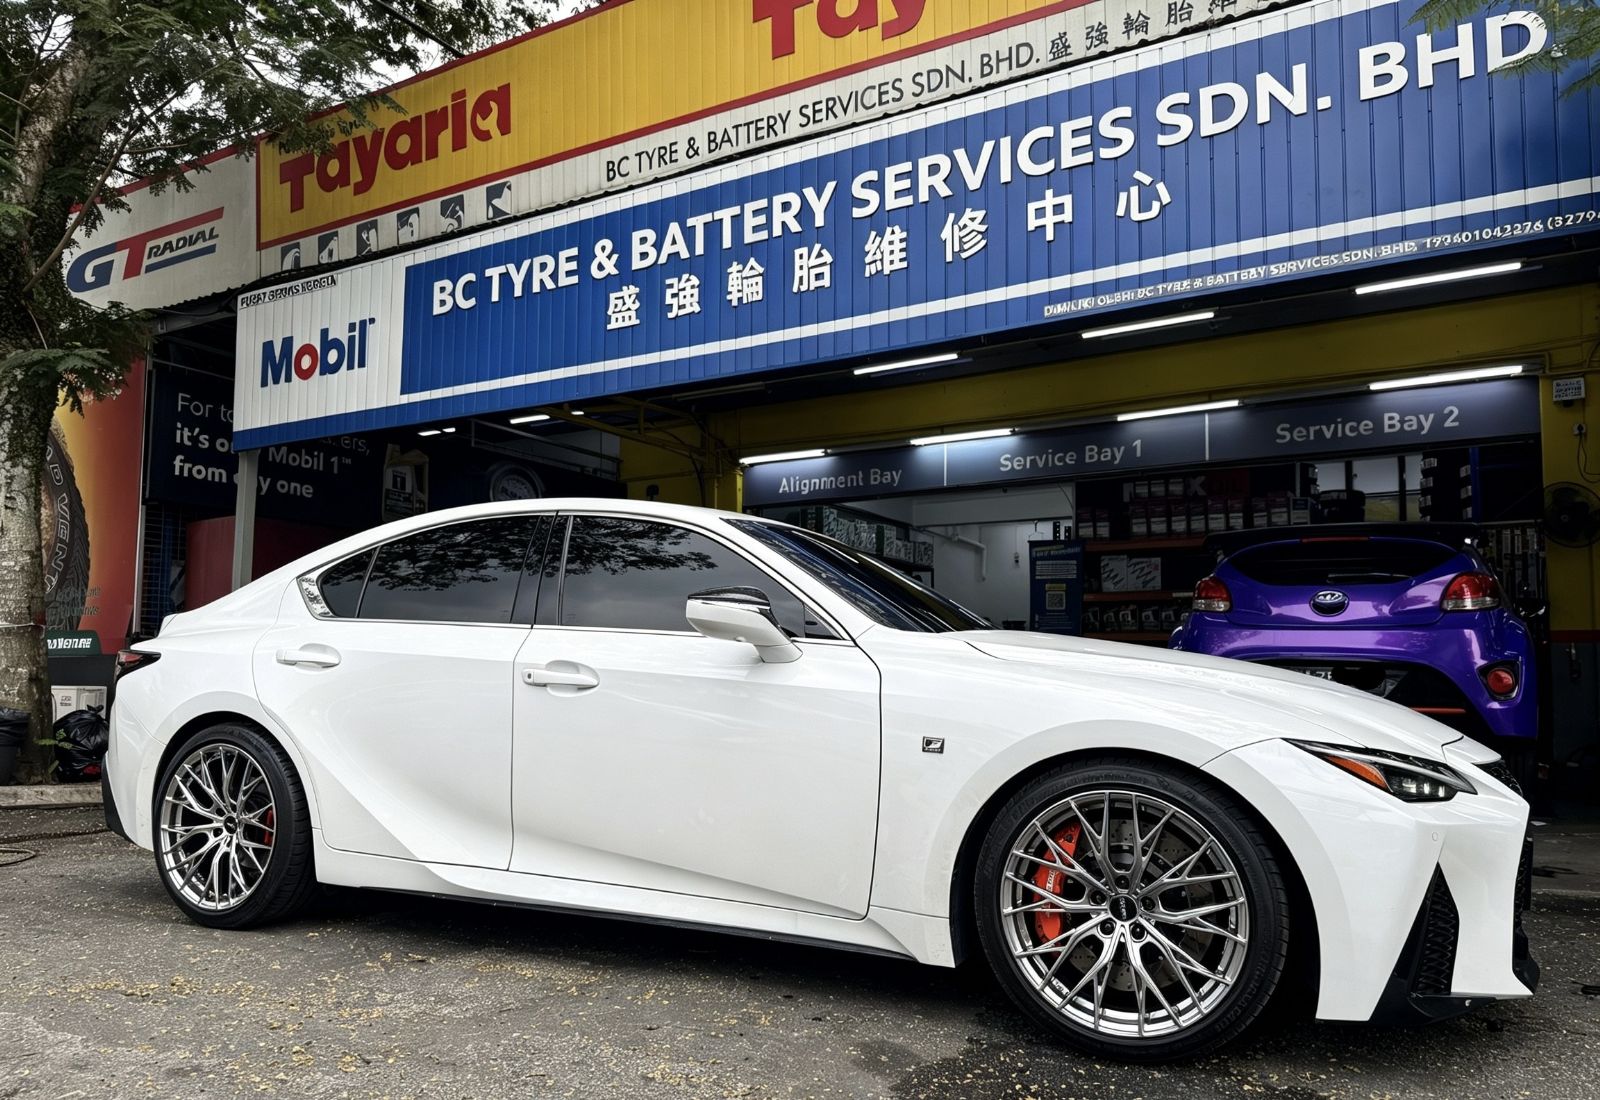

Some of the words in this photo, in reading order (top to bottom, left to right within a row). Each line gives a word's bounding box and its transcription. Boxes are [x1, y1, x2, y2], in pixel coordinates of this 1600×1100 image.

[606, 156, 630, 182] BC
[635, 141, 679, 173] TYRE
[685, 136, 700, 160] &
[707, 113, 788, 154] BATTERY
[798, 77, 904, 128] SERVICES
[911, 59, 973, 98] SDN.
[979, 41, 1041, 79] BHD.
[279, 82, 511, 214] Tayaria
[432, 272, 477, 316] BC
[485, 246, 580, 303] TYRE
[590, 238, 620, 280] &
[631, 180, 838, 271] BATTERY
[851, 106, 1136, 219] SERVICES
[1155, 62, 1333, 147] SDN.
[1547, 209, 1600, 232] (3279
[146, 226, 220, 261] RADIAL
[260, 317, 376, 388] Mobil
[177, 392, 213, 418] For
[1275, 418, 1374, 444] Service
[1383, 412, 1435, 435] Bay
[1443, 405, 1460, 428] 2
[175, 422, 209, 449] it's
[268, 446, 324, 472] Mobil
[1000, 448, 1077, 472] Service
[1085, 444, 1125, 464] Bay
[1131, 438, 1142, 458] 1
[173, 455, 227, 484] from
[276, 479, 314, 498] one
[869, 468, 902, 487] Bay
